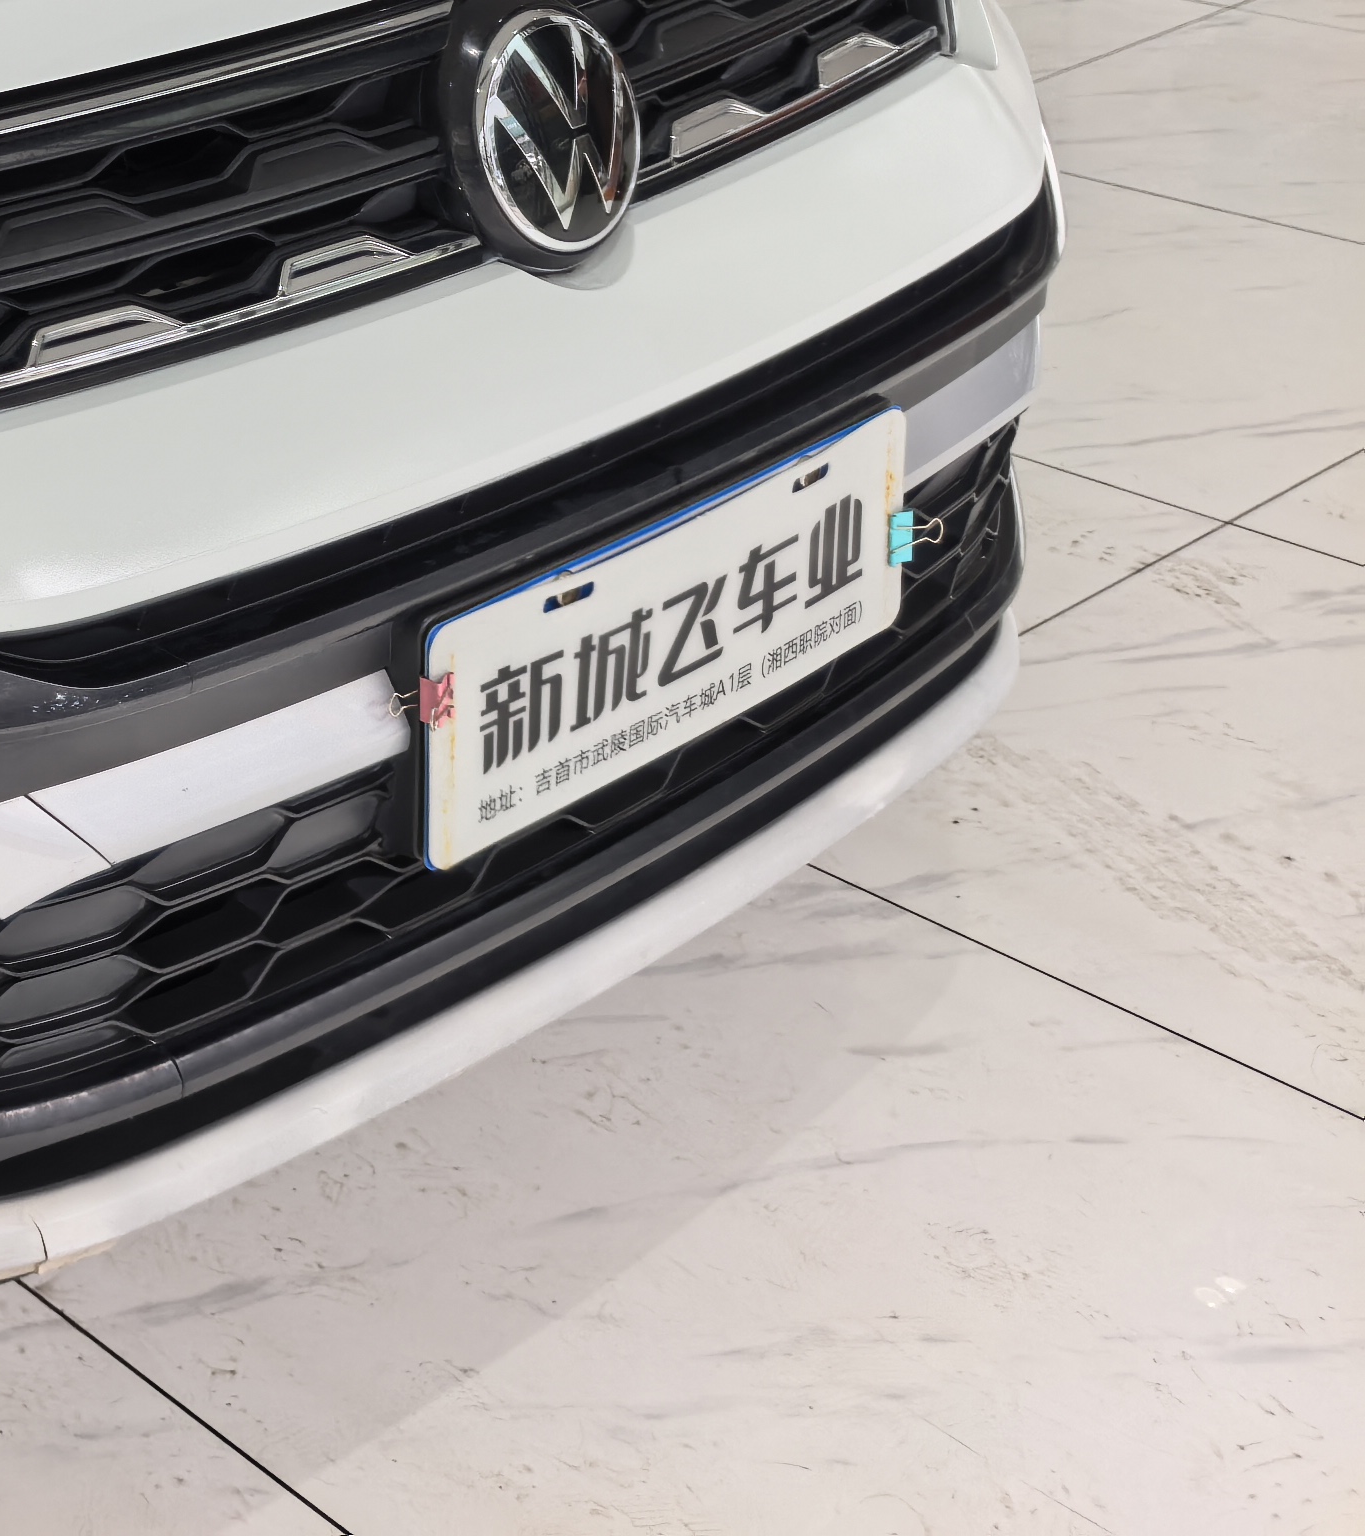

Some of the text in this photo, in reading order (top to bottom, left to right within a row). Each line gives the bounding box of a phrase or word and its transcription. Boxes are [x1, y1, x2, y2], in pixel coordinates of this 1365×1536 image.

[480, 494, 863, 774] 新城飞车业
